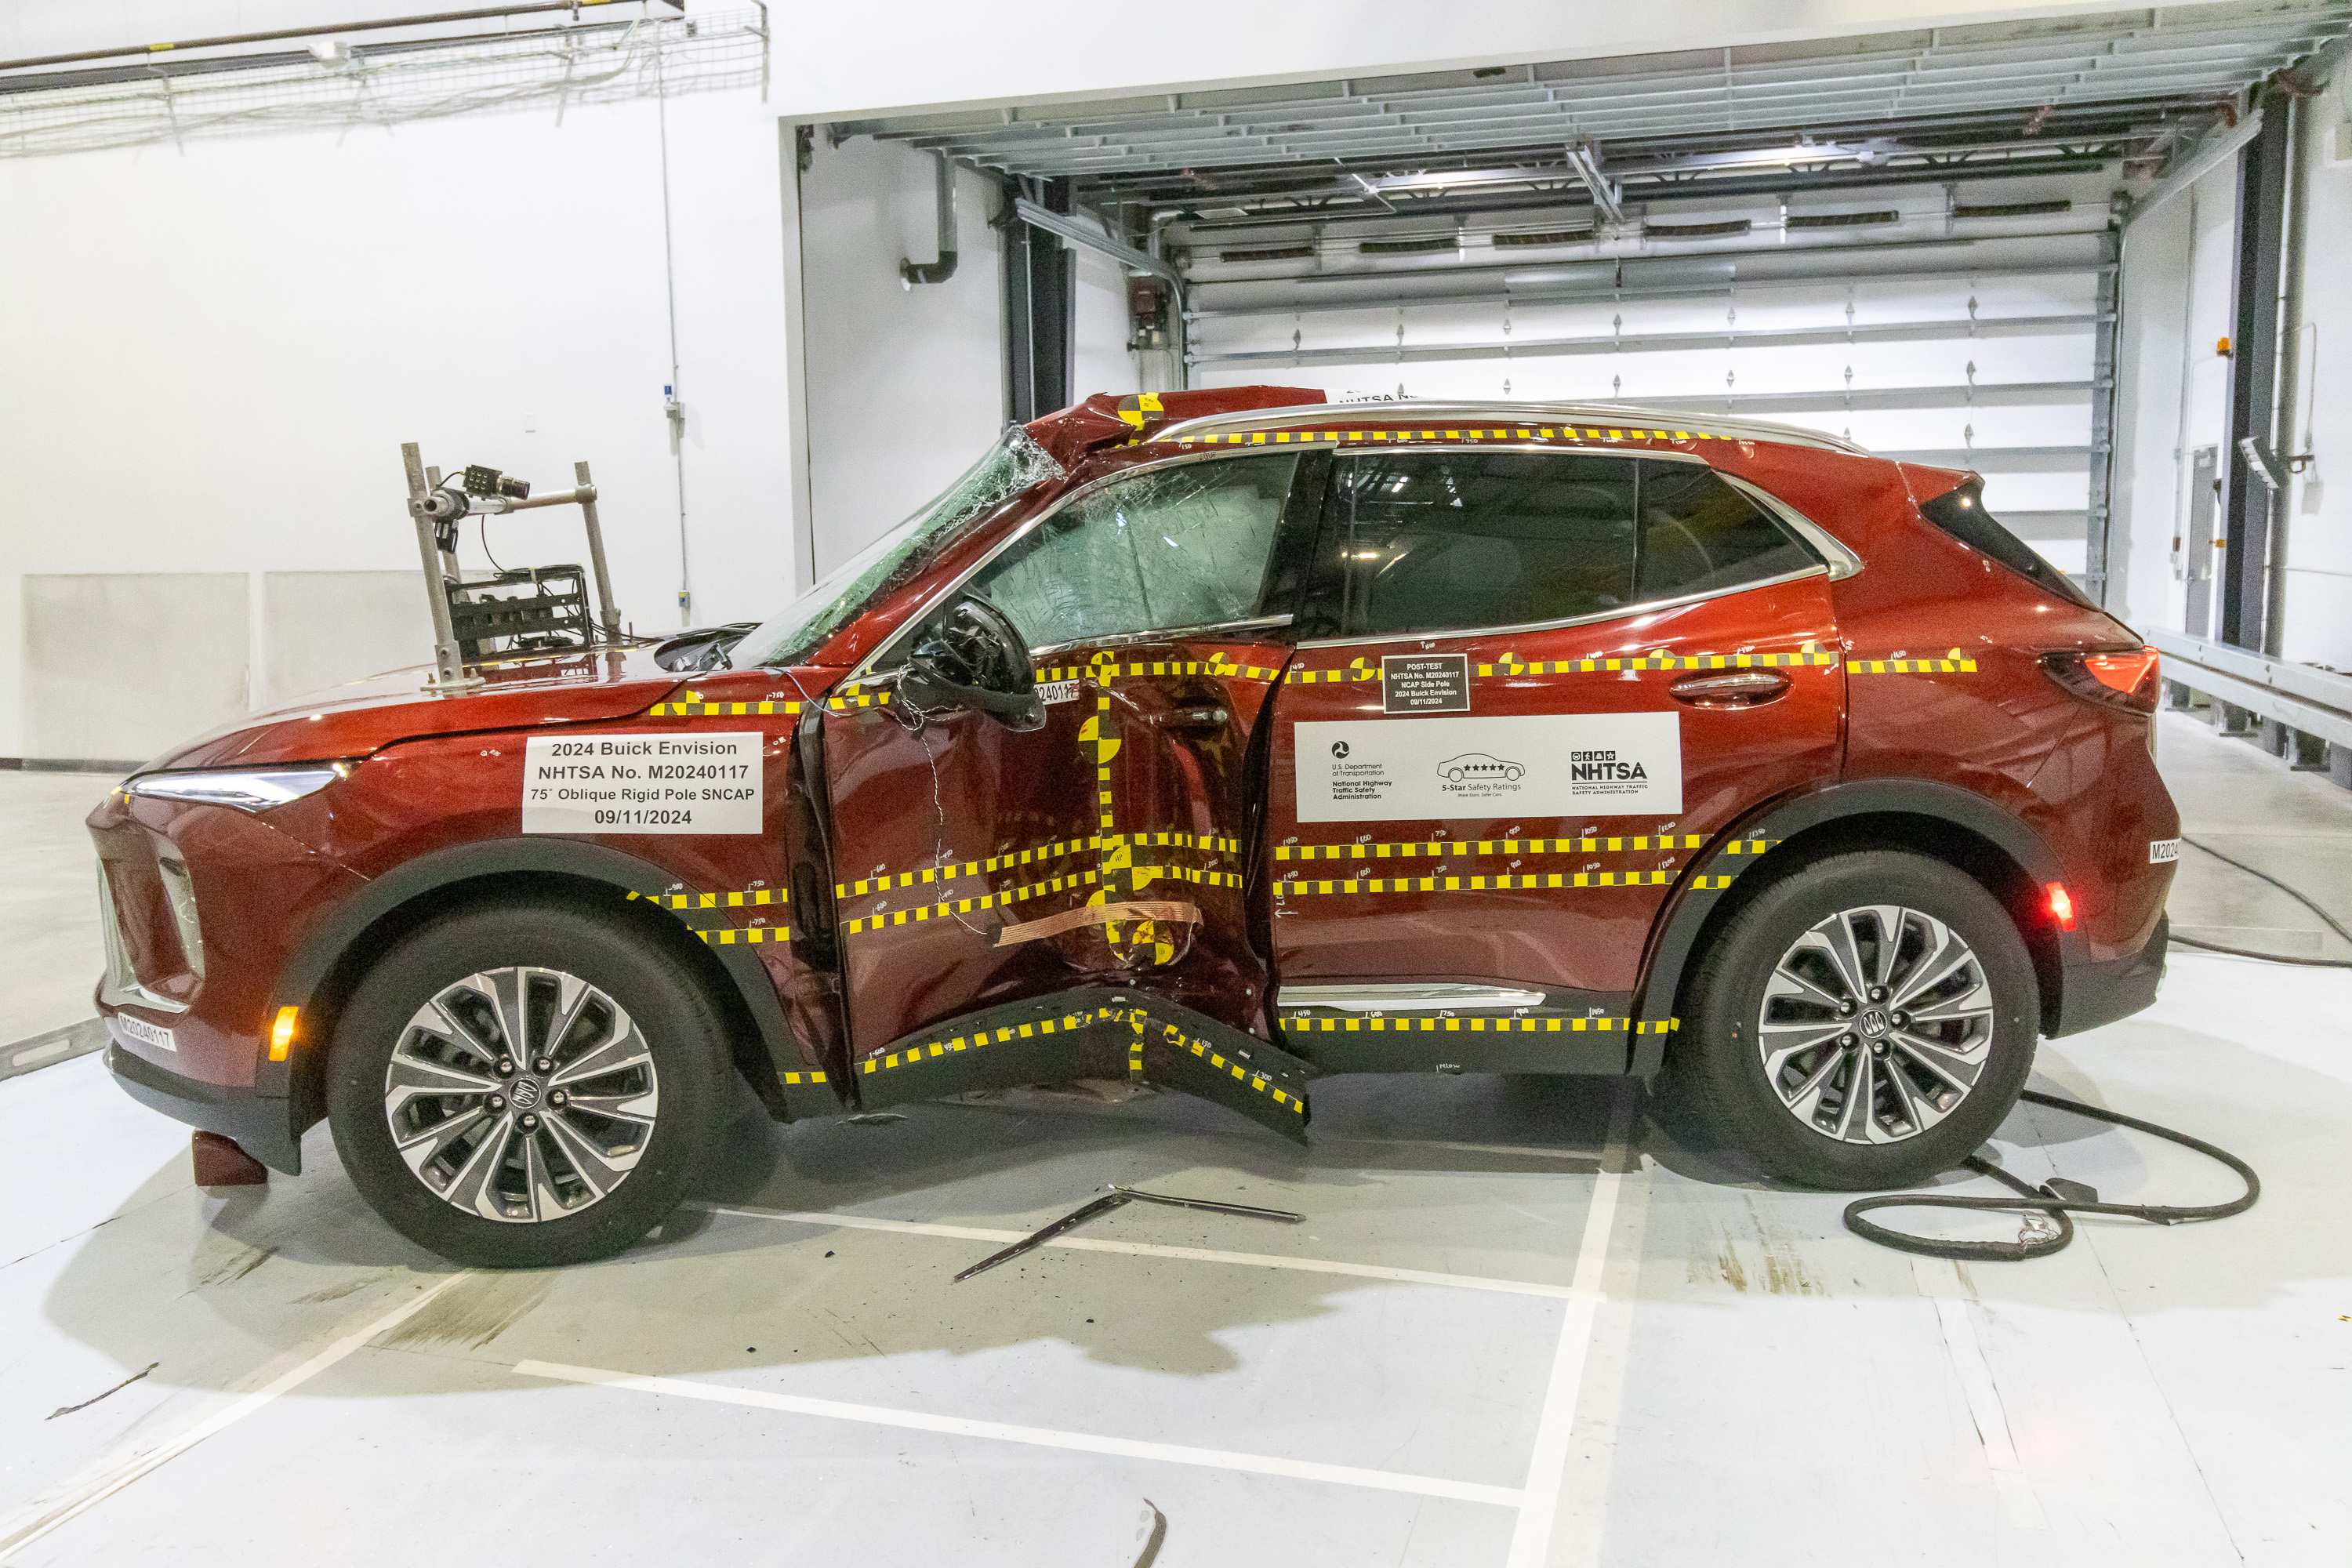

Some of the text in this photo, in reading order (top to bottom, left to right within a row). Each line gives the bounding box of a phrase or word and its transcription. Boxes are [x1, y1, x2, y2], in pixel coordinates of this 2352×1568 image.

[1339, 394, 1394, 403] TSA
[1035, 683, 1076, 702] 240117
[552, 741, 737, 757] 2024 Buick Envision
[539, 764, 749, 780] NHTSA No. M20240117
[1571, 762, 1647, 781] NHTSA
[1468, 783, 1490, 792] Safety
[531, 788, 755, 803] 75° Oblique Rigid Pole SNCAP
[594, 810, 692, 824] 09/11/2024
[1359, 834, 1371, 843] 600
[2152, 844, 2180, 860] M2024
[120, 1015, 170, 1048] M20240117
[1261, 1072, 1272, 1081] 300
